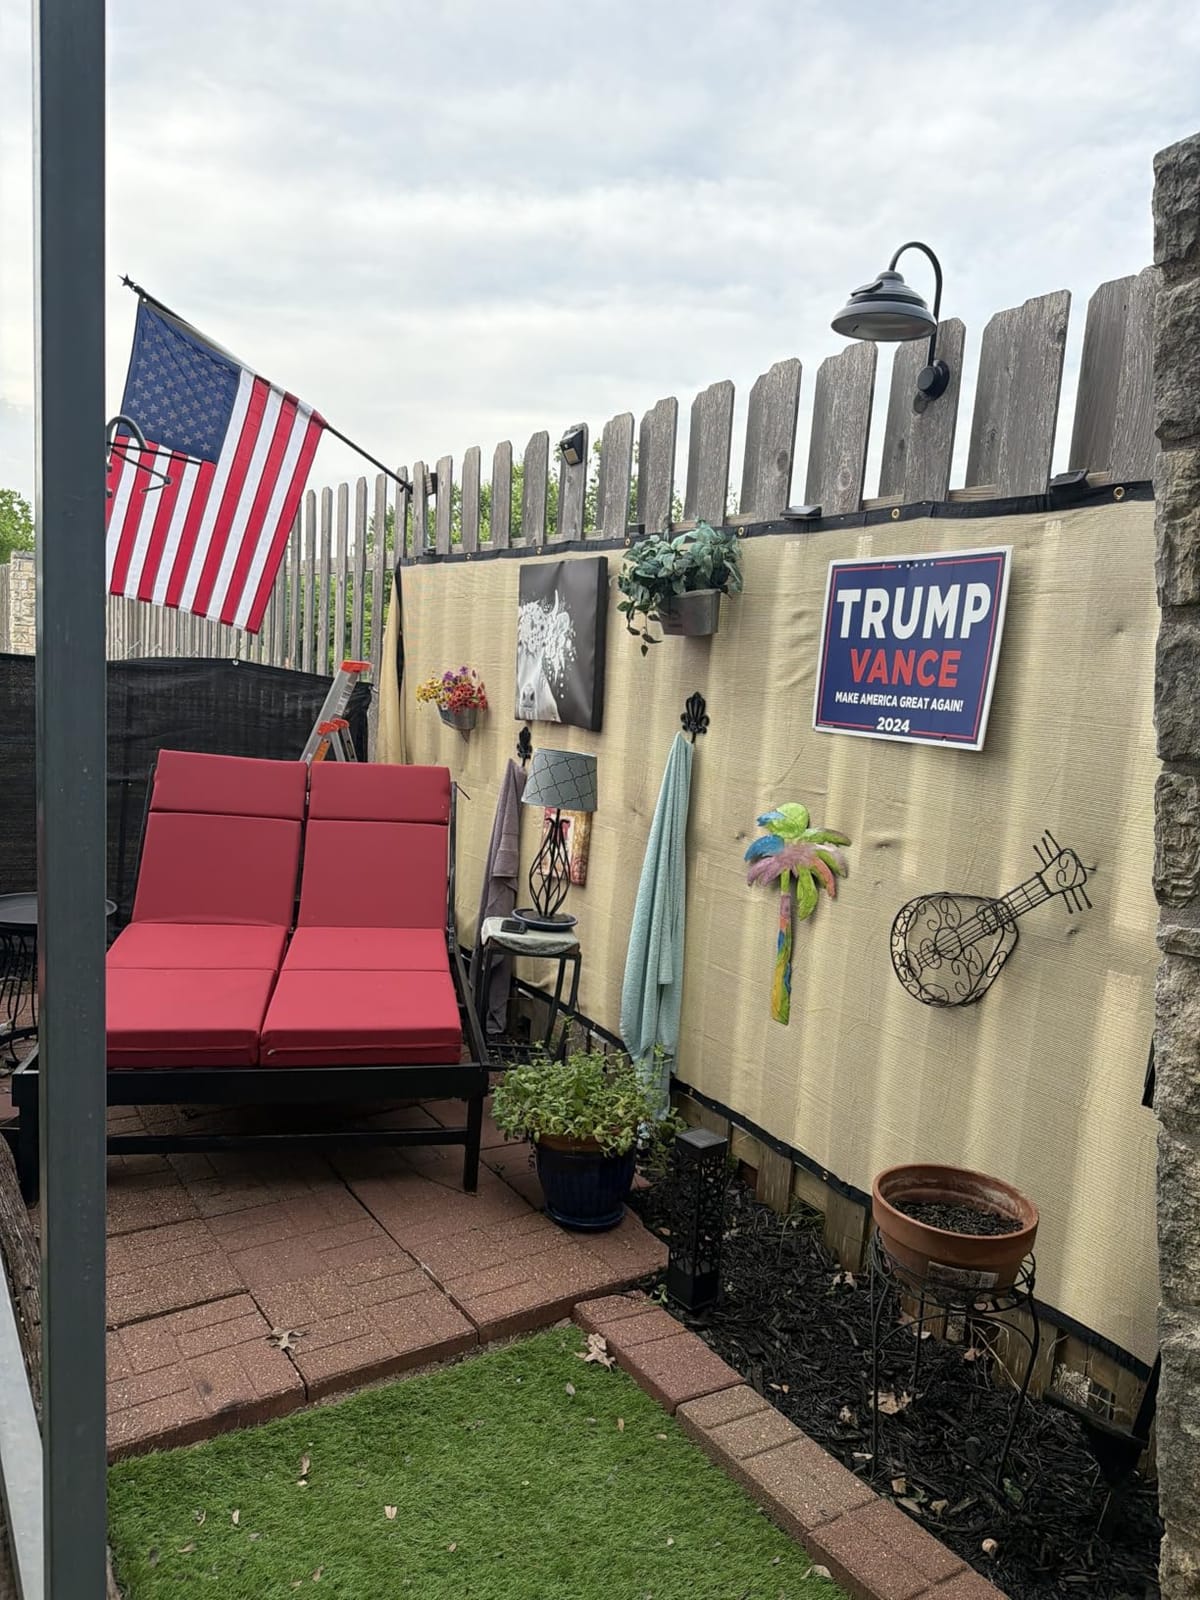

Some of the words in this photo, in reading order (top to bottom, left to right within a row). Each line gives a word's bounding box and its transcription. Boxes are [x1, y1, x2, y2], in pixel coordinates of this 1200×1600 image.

[836, 583, 991, 639] TRUMP
[850, 648, 962, 688] VANCE
[835, 691, 859, 704] MAKE
[860, 693, 898, 707] AMERICA
[899, 696, 930, 709] GREAT
[930, 698, 964, 712] AGAIN!
[876, 716, 911, 733] 2024
